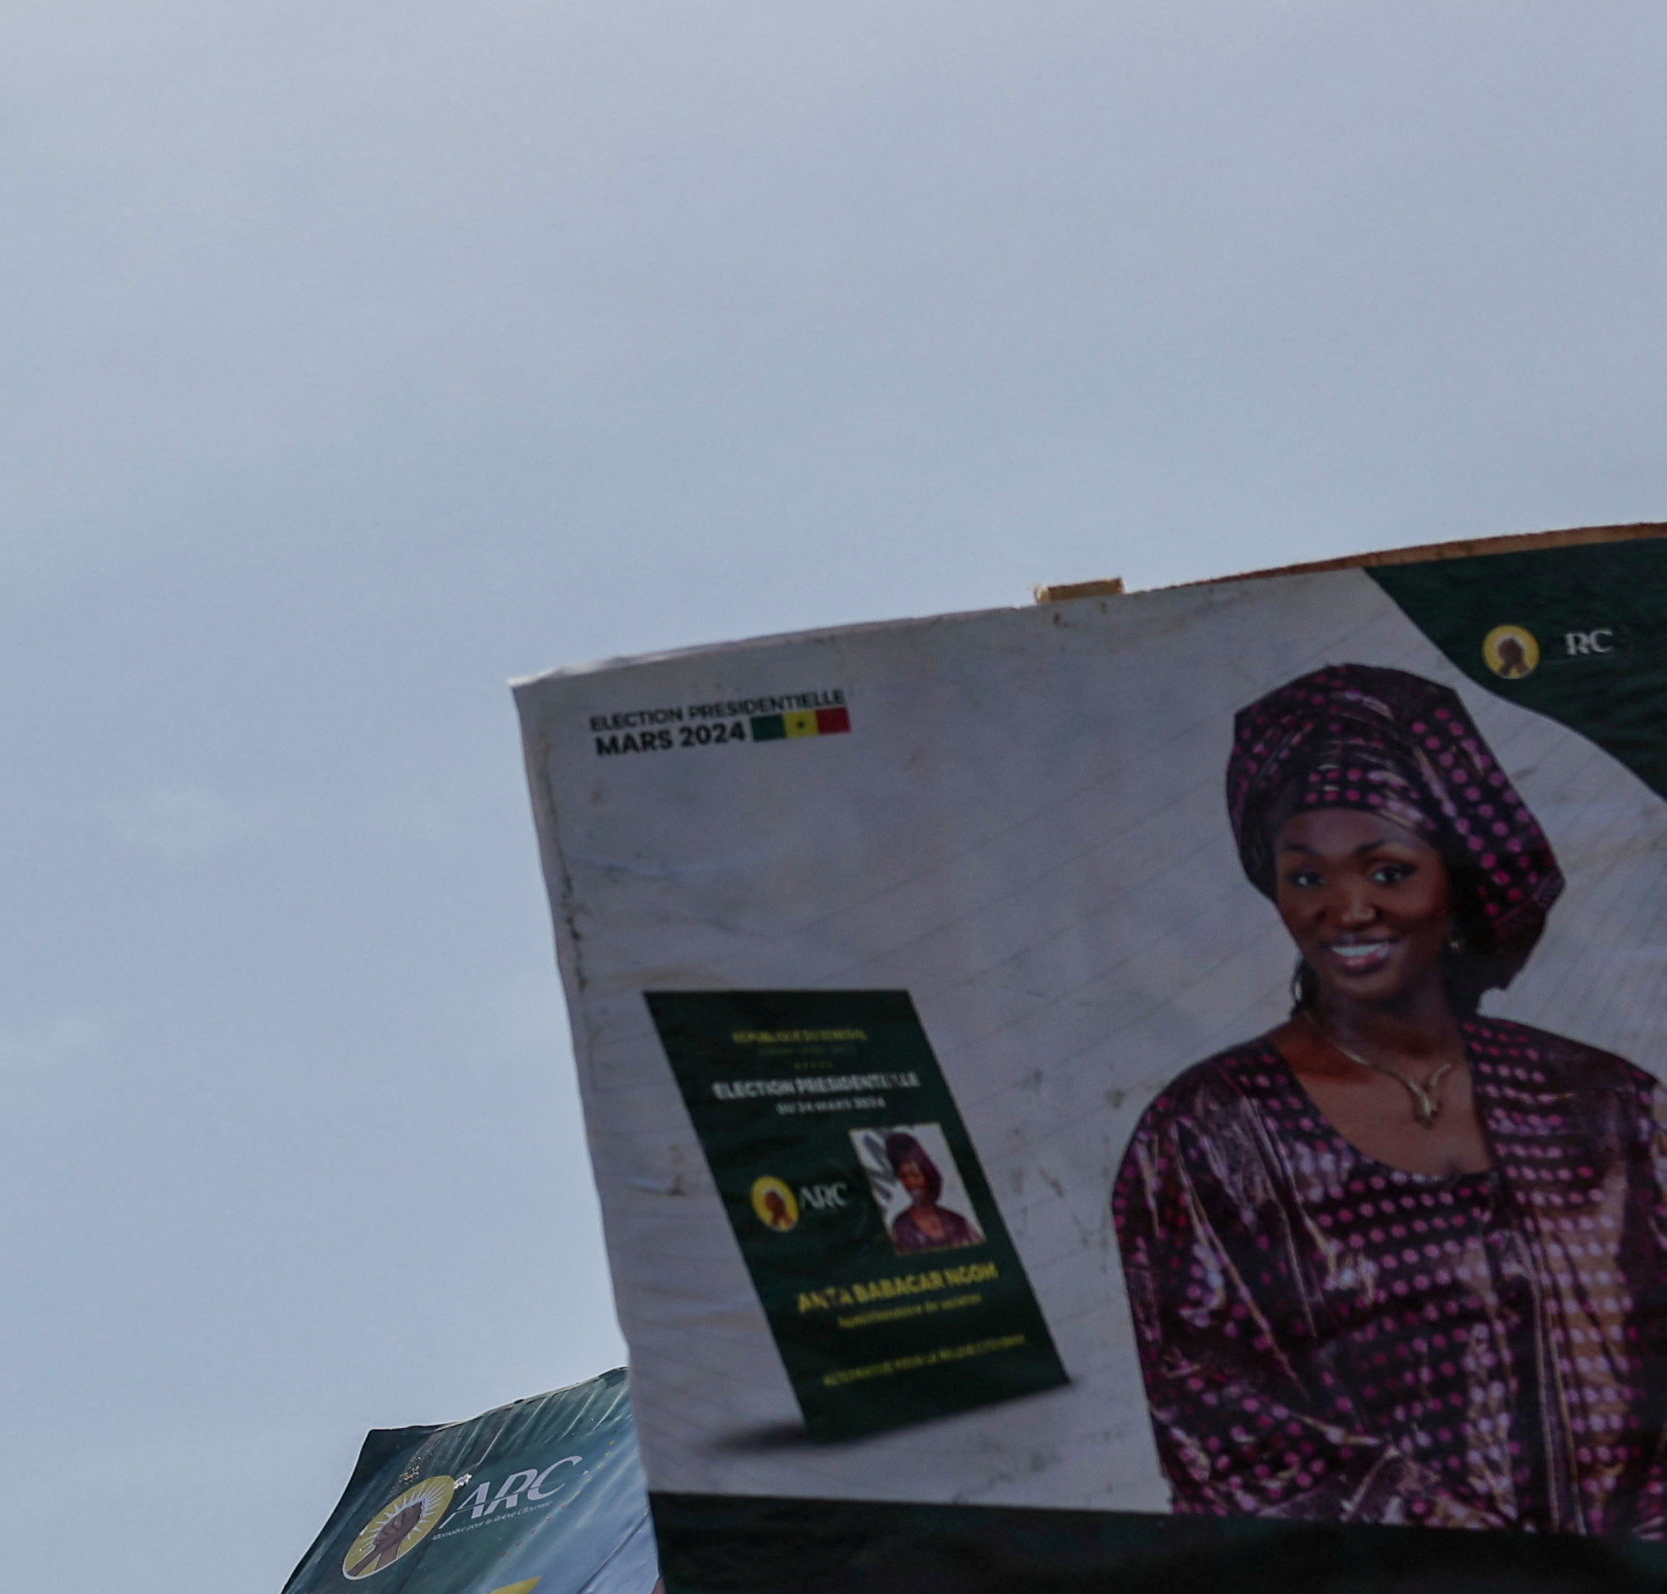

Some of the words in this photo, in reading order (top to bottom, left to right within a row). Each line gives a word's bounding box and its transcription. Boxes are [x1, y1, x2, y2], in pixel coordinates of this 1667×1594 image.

[1565, 628, 1614, 656] RC
[590, 708, 684, 732] ELECTION
[688, 688, 847, 720] PRESIDENTIELLE
[595, 728, 673, 758] MARS
[678, 720, 747, 748] 2024
[798, 1182, 848, 1210] ARC
[438, 1455, 583, 1530] ARC
